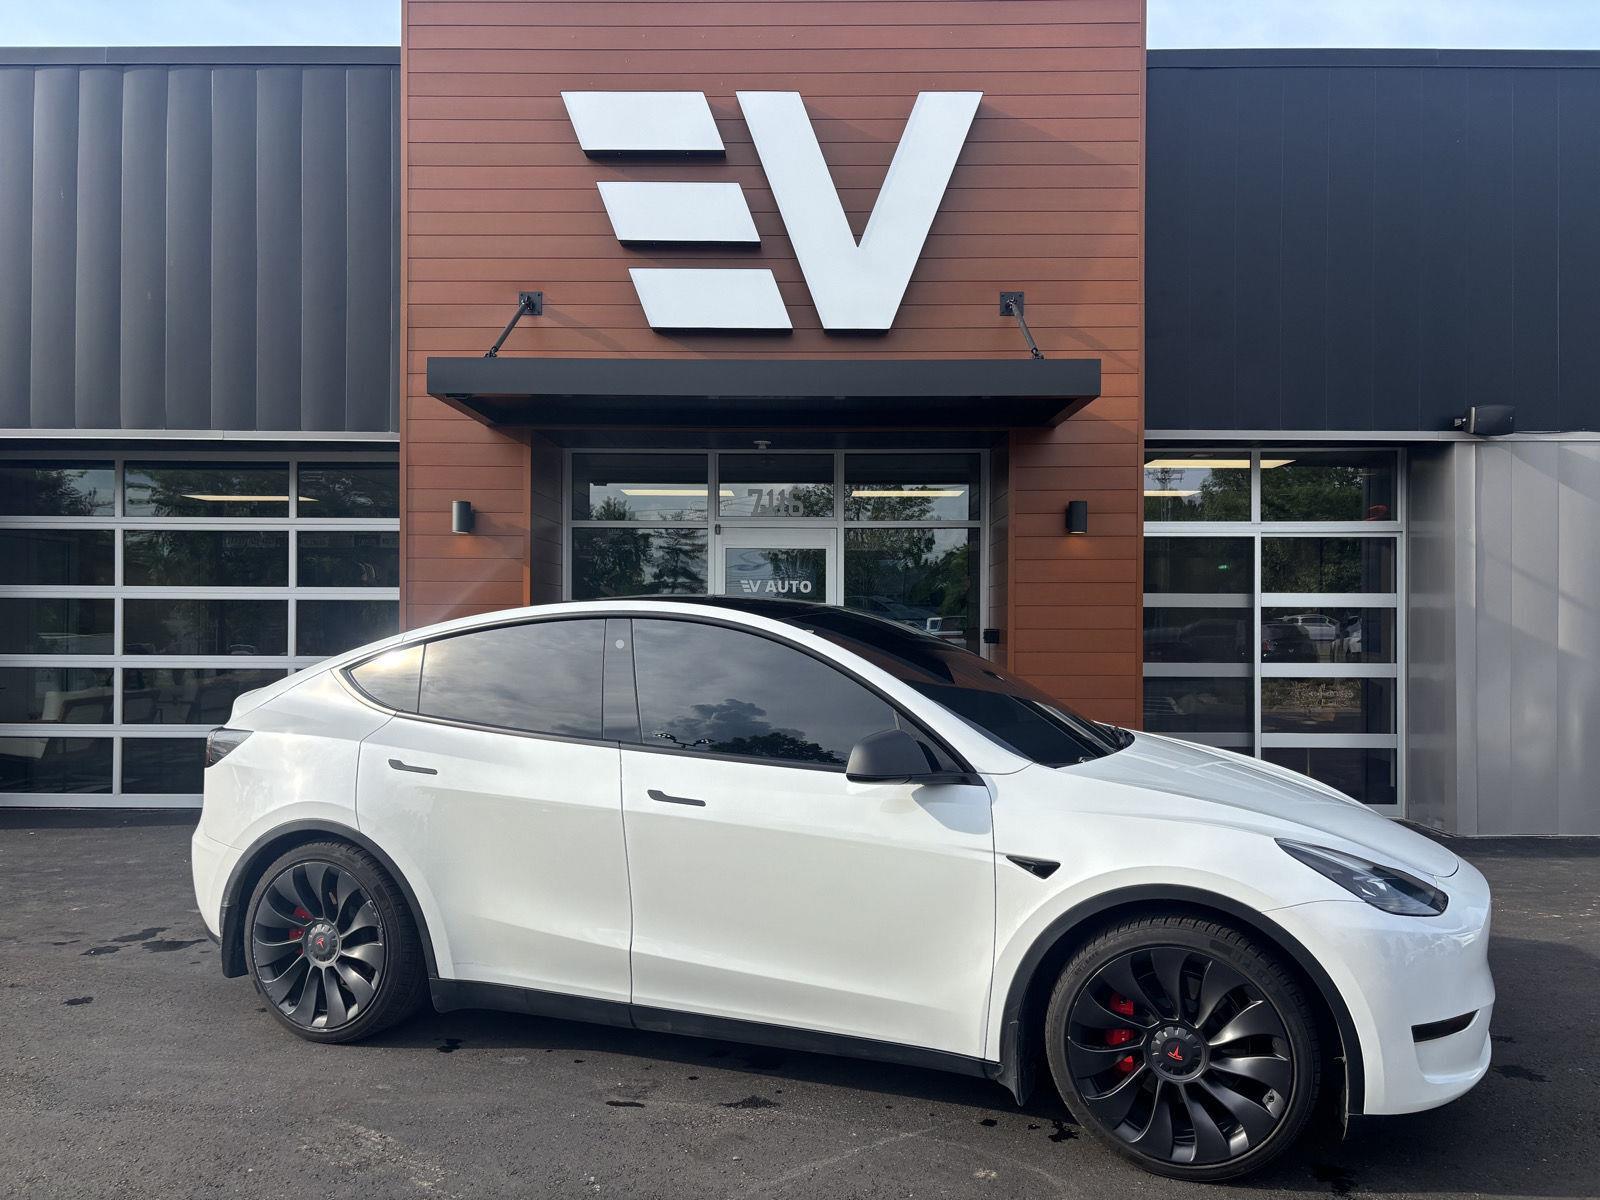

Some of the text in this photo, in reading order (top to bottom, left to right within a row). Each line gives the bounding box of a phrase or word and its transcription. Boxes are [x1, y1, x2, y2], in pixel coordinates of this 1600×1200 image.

[560, 90, 984, 331] EV
[747, 488, 803, 517] 7116
[740, 579, 812, 594] EV AUTO
